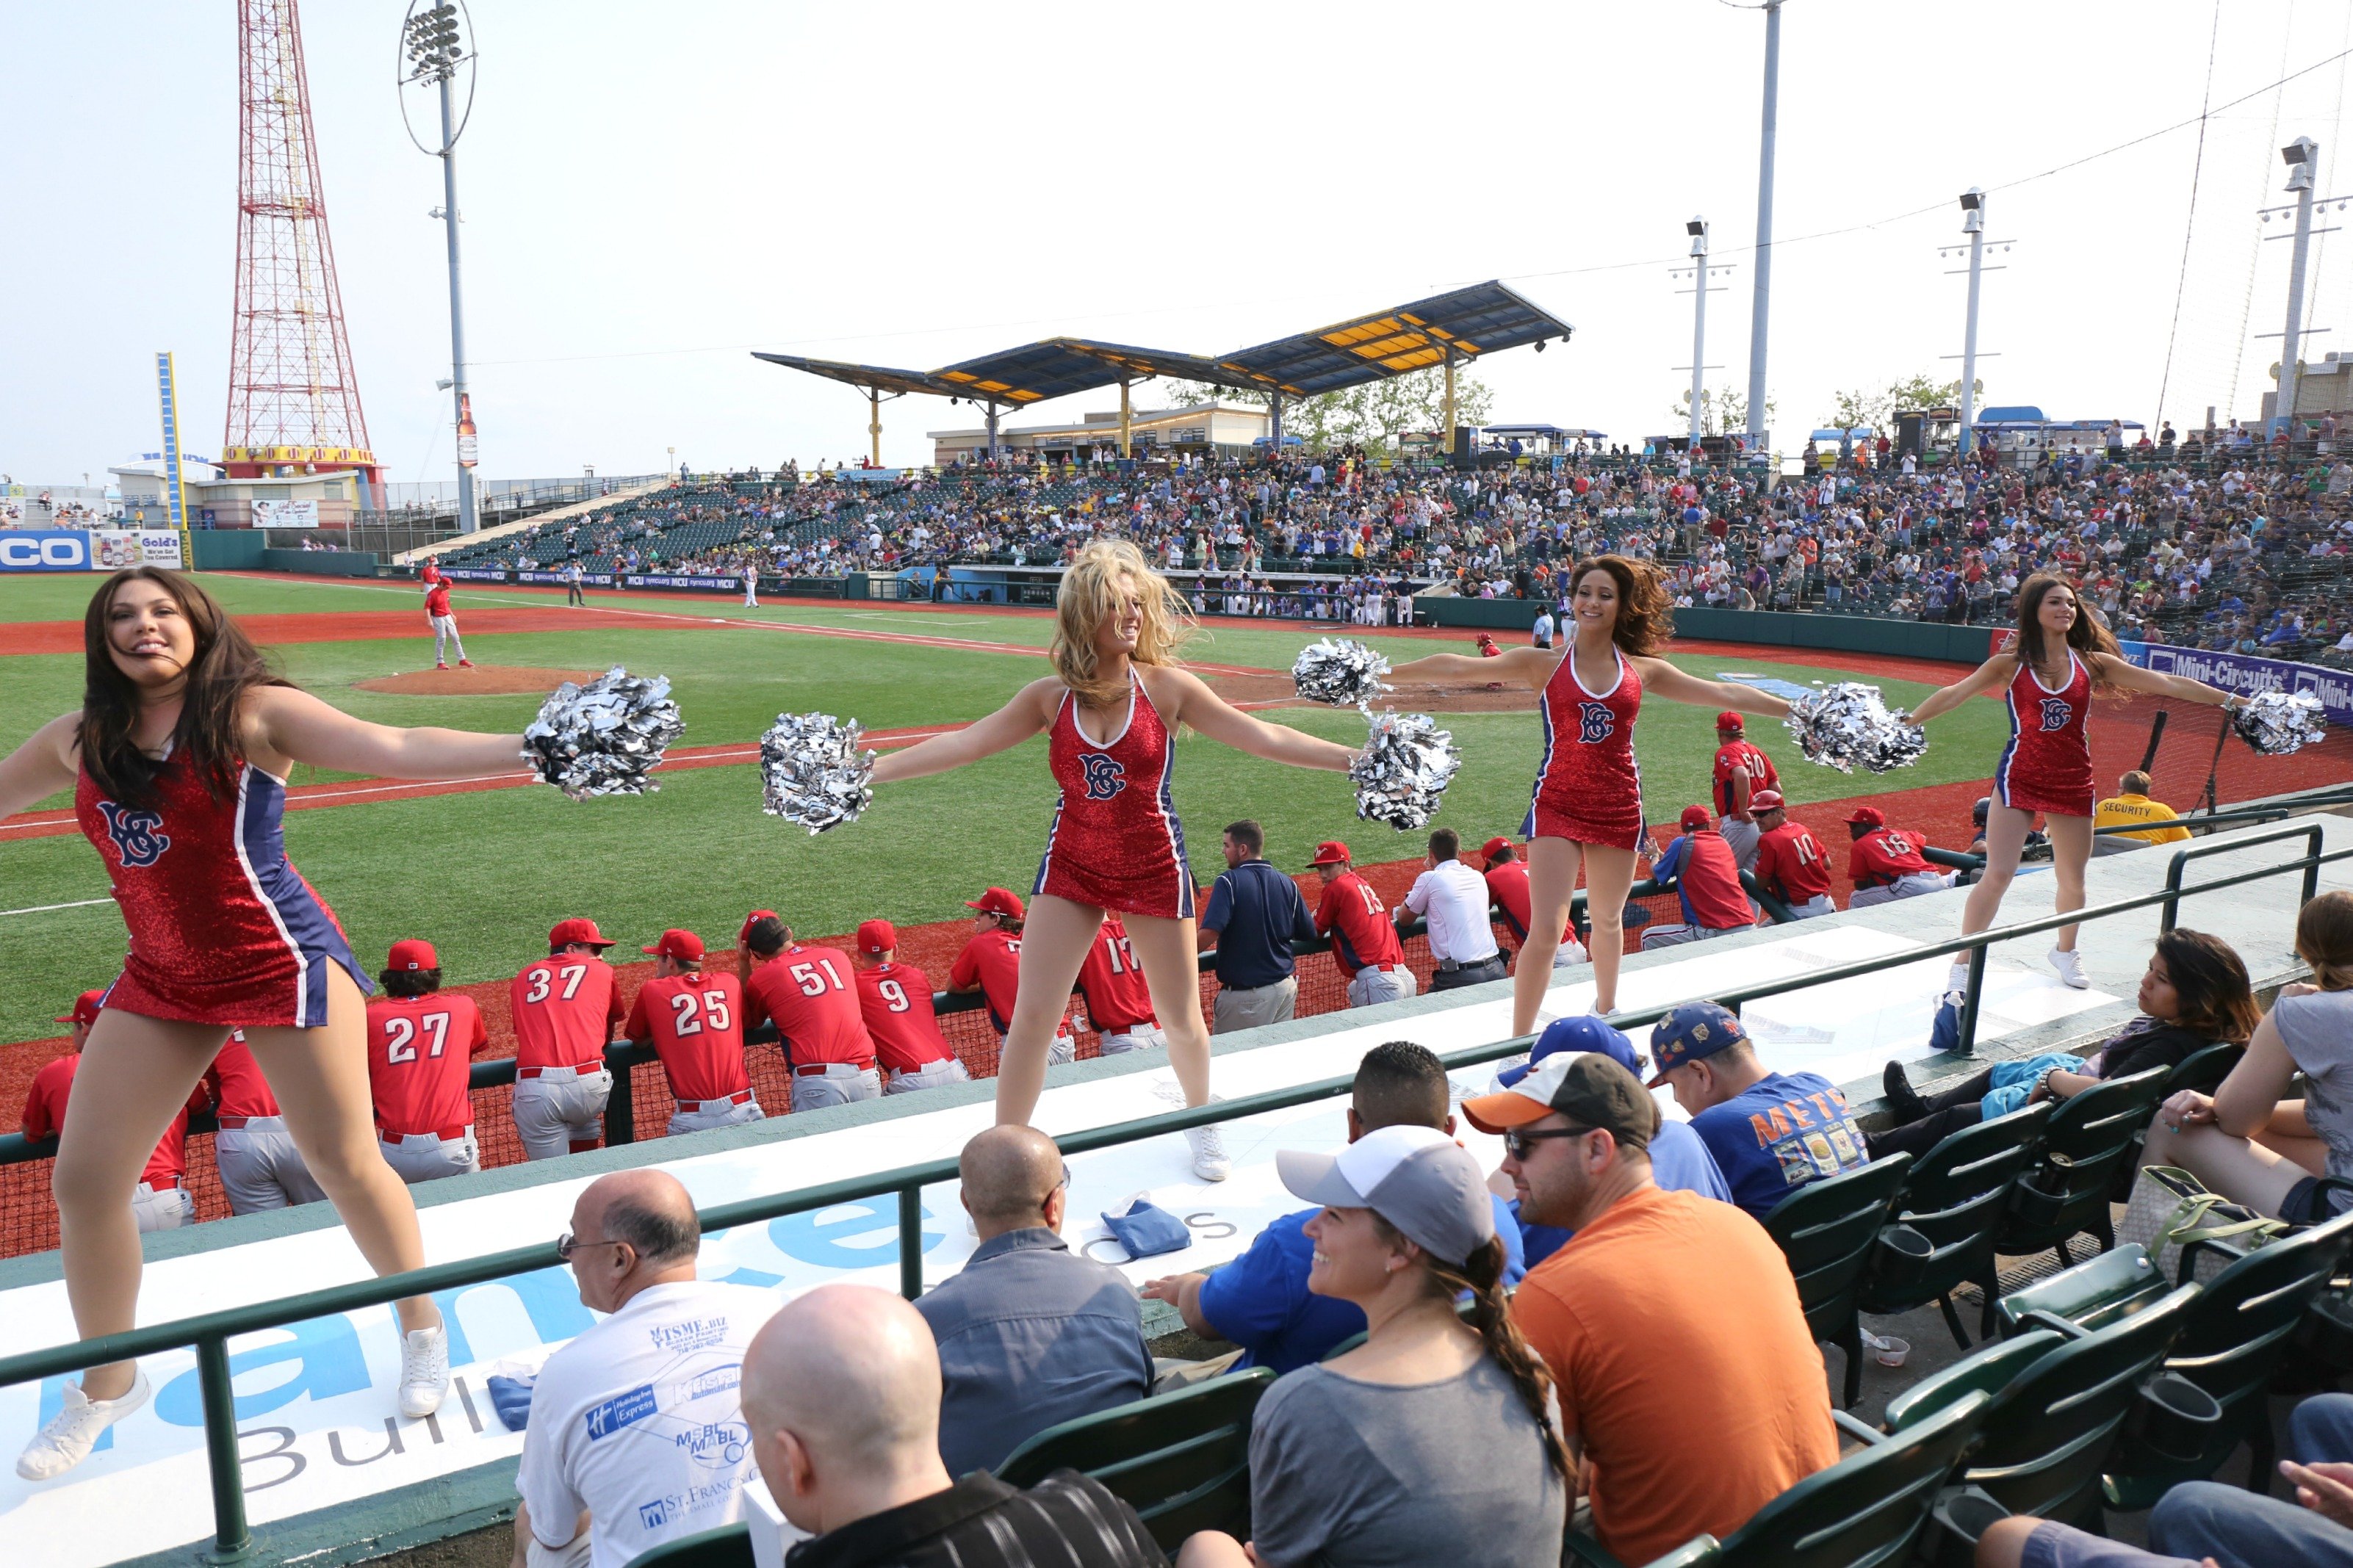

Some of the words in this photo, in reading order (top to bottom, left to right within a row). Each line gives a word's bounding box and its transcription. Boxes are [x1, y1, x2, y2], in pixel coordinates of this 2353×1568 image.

[143, 538, 178, 547] Gold's
[458, 570, 471, 579] MCU
[491, 571, 505, 580] MCU
[519, 572, 533, 582] MCU
[556, 573, 569, 582] MC
[595, 575, 611, 584] MCU
[628, 576, 644, 585] MCU
[646, 577, 669, 586] nymcu.org
[671, 577, 688, 587] MCU
[690, 579, 715, 588] nymcu.org
[717, 579, 735, 589] MCU
[2318, 676, 2353, 710] Mini-
[1740, 752, 1766, 779] 50
[2103, 802, 2151, 817] SECURITY
[1792, 833, 1818, 867] 10
[1875, 833, 1911, 859] 16
[1356, 883, 1386, 917] 13
[525, 964, 588, 1004] 37
[788, 958, 846, 997] 51
[878, 978, 912, 1014] 9
[671, 989, 731, 1038] 25
[384, 1011, 451, 1066] 27
[1748, 1087, 1851, 1150] METS
[616, 1393, 641, 1409] Holiday
[641, 1390, 652, 1399] Inn
[619, 1400, 654, 1422] Express
[676, 1423, 723, 1447] MSBL
[690, 1429, 737, 1454] MABL
